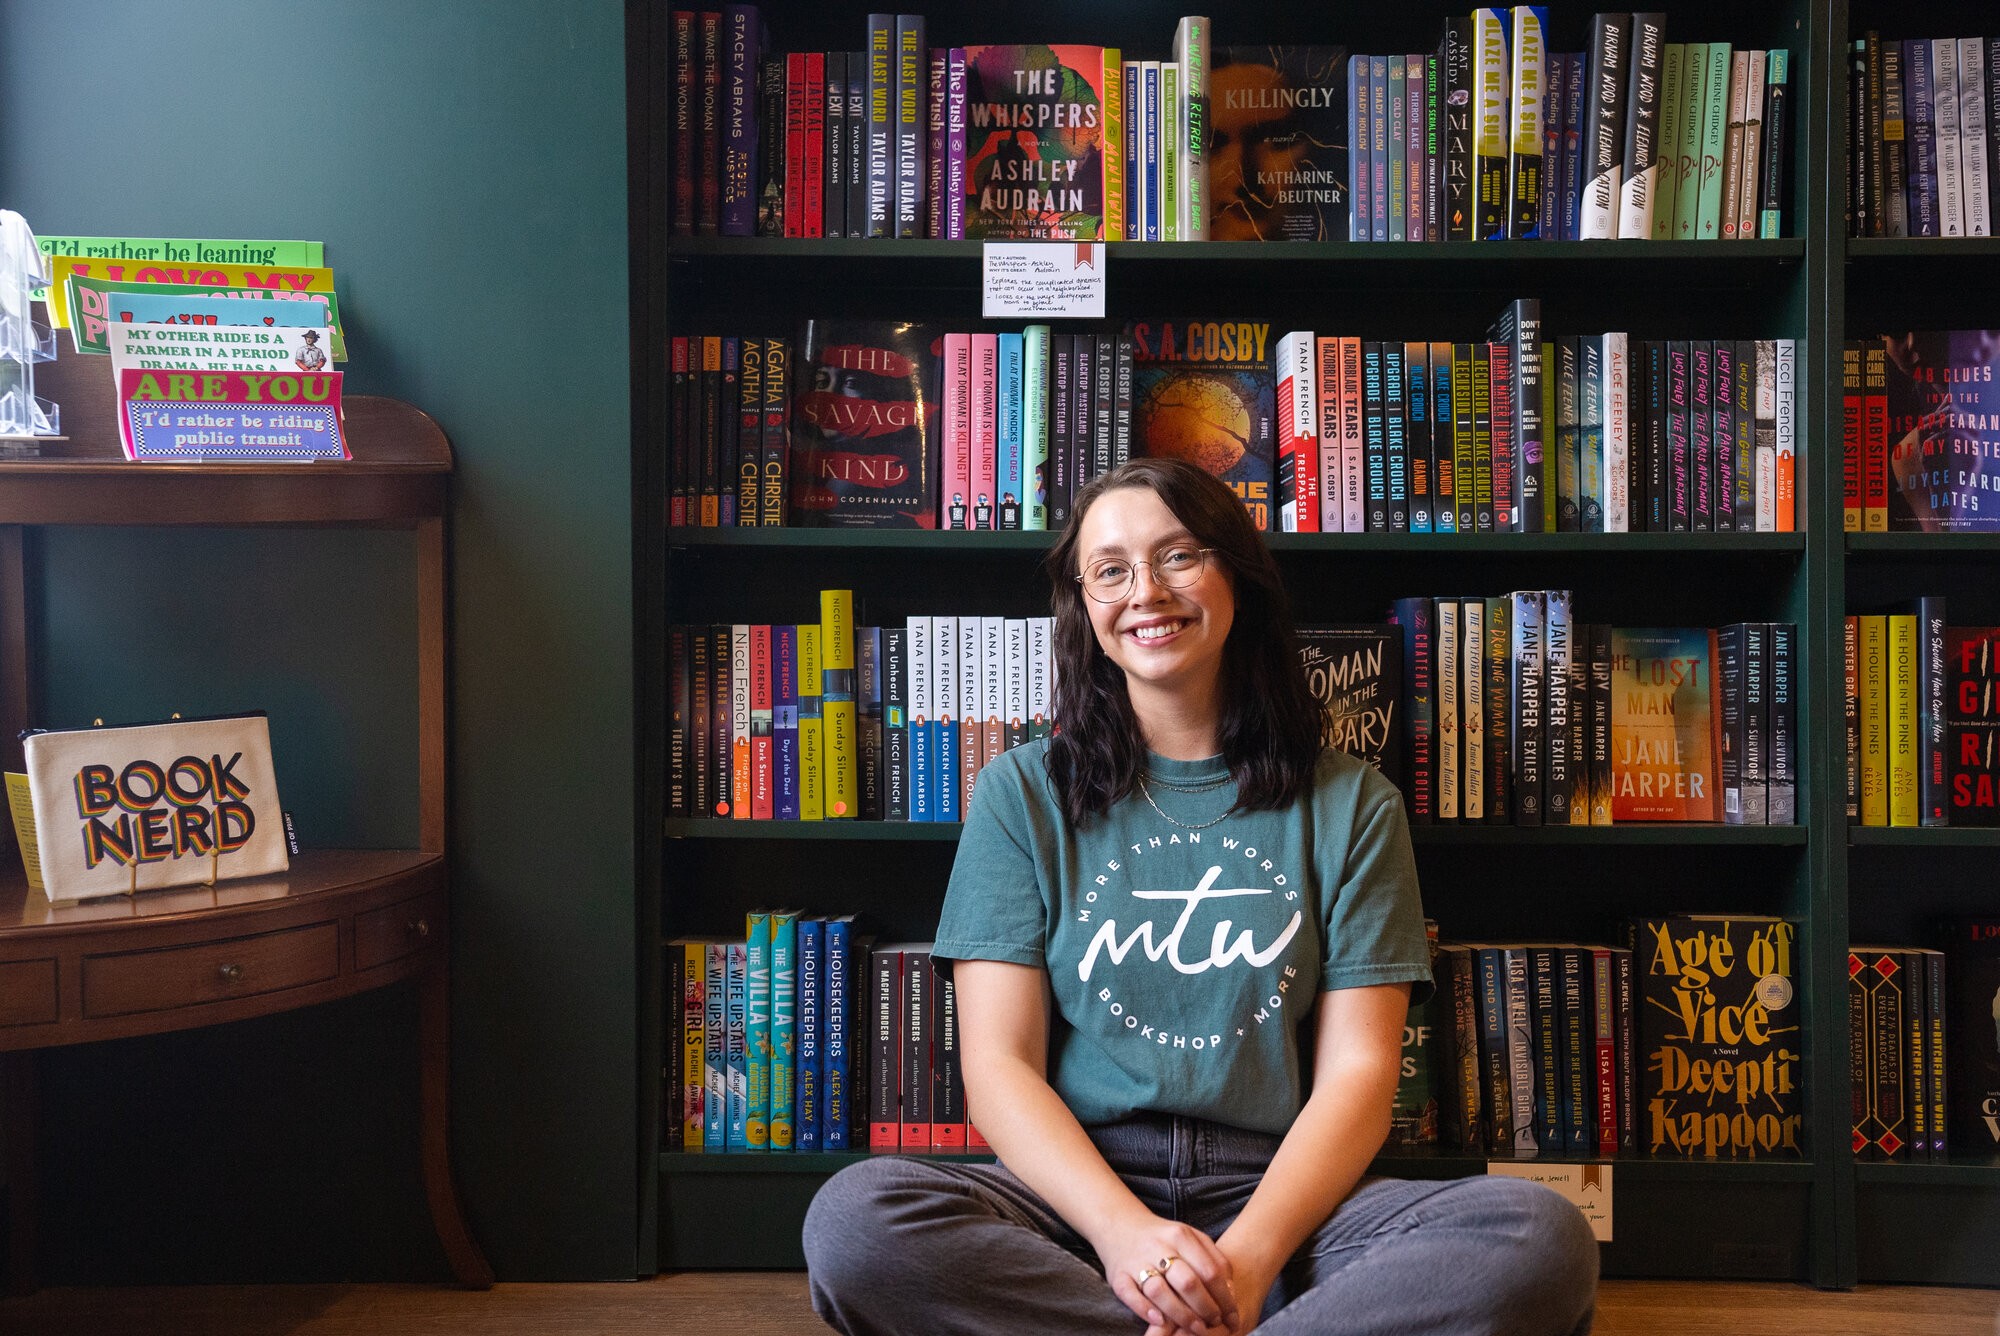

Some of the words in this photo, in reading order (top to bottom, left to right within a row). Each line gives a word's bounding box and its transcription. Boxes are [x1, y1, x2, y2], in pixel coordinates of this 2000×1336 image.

[734, 14, 744, 71] STACEY
[873, 29, 888, 51] THE
[873, 55, 887, 83] LAST
[1428, 59, 1436, 73] MY
[1448, 30, 1457, 85] CASSIDY
[1459, 45, 1468, 71] NAT
[1885, 52, 1898, 80] IRON
[950, 60, 964, 91] The
[1014, 70, 1055, 95] THE
[1428, 72, 1436, 93] SISTER
[1713, 52, 1723, 102] CATHERINE
[731, 77, 743, 138] ABRAMS
[872, 91, 887, 123] WORD
[950, 94, 964, 133] Push
[1225, 88, 1335, 109] KILLINGLY
[1358, 86, 1366, 115] SHADY
[1428, 96, 1436, 108] THE
[1886, 87, 1899, 115] LAKE
[971, 104, 1097, 128] WHISPERS
[1428, 109, 1436, 131] SERIAL
[1711, 104, 1720, 146] CHIDGEY
[1358, 117, 1366, 150] HOLLOW
[1428, 133, 1436, 155] KILLER
[871, 133, 886, 177] TAYLOR
[991, 160, 1077, 181] ASHLEY
[1448, 113, 1468, 200] MARY
[951, 158, 962, 192] Ashley
[1257, 171, 1334, 185] KATHARINE
[871, 181, 885, 221] ADAMS
[980, 189, 1083, 212] AUDRAIN
[1278, 190, 1341, 204] BEUTNER
[951, 196, 962, 238] Audrain
[86, 243, 159, 260] rather
[165, 243, 190, 263] be
[196, 244, 276, 266] leaning
[128, 330, 150, 340] MY
[156, 331, 208, 342] OTHER
[213, 332, 251, 342] RIDE
[255, 333, 269, 343] IS
[273, 334, 284, 343] A
[1521, 320, 1540, 329] DON'T
[1521, 332, 1534, 340] SAY
[125, 345, 193, 356] FARMER
[195, 347, 212, 357] IN
[216, 348, 230, 357] A
[232, 348, 289, 359] PERIOD
[1187, 323, 1270, 362] COSBY
[1298, 341, 1308, 372] TANA
[1521, 343, 1532, 351] WE
[1521, 354, 1542, 362] DIDN'T
[766, 339, 784, 403] AGATHA
[839, 349, 895, 371] THE
[1323, 343, 1336, 394] RAZORBLADE
[1521, 365, 1541, 374] WARN
[1613, 352, 1622, 388] ALICE
[1780, 346, 1792, 383] Nicci
[131, 374, 228, 401] ARE
[240, 375, 333, 401] YOU
[1365, 353, 1379, 402] UPGRADE
[1456, 360, 1470, 414] RECURSION
[1522, 377, 1536, 385] YOU
[1301, 376, 1309, 425] FRENCH
[142, 411, 170, 427] I'd
[177, 412, 235, 428] rather
[241, 414, 263, 428] be
[269, 415, 324, 431] riding
[1324, 398, 1337, 439] TEARS
[1367, 417, 1382, 450] BLAKE
[1614, 393, 1622, 442] FEENEY
[1780, 391, 1792, 444] French
[174, 431, 235, 448] public
[241, 433, 302, 446] transit
[1869, 406, 1883, 498] BABYSITTER
[822, 458, 904, 480] KIND
[1369, 455, 1384, 500] CROUCH
[1413, 459, 1426, 495] ABANDON
[764, 462, 781, 525] CHRISTIE
[840, 496, 918, 505] COPENHAVER
[1297, 453, 1306, 521] TRESPASSER
[1308, 477, 1316, 497] THE
[1470, 612, 1479, 626] THE
[1899, 625, 1907, 643] THE
[735, 634, 747, 671] Nicci
[756, 630, 764, 660] NICCI
[889, 634, 899, 653] The
[916, 625, 924, 657] TANA
[1470, 630, 1479, 676] TWYFORD
[1523, 621, 1538, 660] JANE
[1749, 630, 1761, 656] JANE
[1845, 624, 1854, 670] SINISTER
[781, 663, 789, 699] FRENCH
[890, 656, 899, 700] Unheard
[1636, 659, 1701, 687] LOST
[1748, 661, 1760, 703] HARPER
[1898, 648, 1908, 685] HOUSE
[757, 664, 765, 705] FRENCH
[916, 664, 924, 709] FRENCH
[1470, 679, 1479, 705] CODE
[1522, 667, 1538, 728] HARPER
[1846, 676, 1855, 717] GRAVES
[1900, 688, 1908, 699] IN
[735, 678, 748, 730] French
[1627, 692, 1675, 716] MAN
[1900, 702, 1908, 720] THE
[834, 712, 845, 751] Sunday
[1900, 725, 1909, 755] PINES
[1524, 741, 1536, 783] EXILES
[1621, 738, 1684, 765] JANE
[73, 752, 251, 820] BOOK
[757, 764, 766, 800] Saturday
[837, 754, 846, 795] Silence
[81, 801, 256, 870] NERD
[289, 832, 295, 840] OF
[1078, 860, 1120, 922] MORE
[1132, 833, 1201, 855] THAN
[1223, 837, 1298, 901] WORDS
[1078, 866, 1301, 982] mtw
[750, 946, 760, 966] THE
[1598, 961, 1606, 978] THE
[1648, 921, 1735, 988] Age
[1747, 921, 1794, 978] of
[730, 968, 742, 998] WIFE
[749, 969, 769, 1025] VILLA
[880, 970, 889, 1001] MAGPIE
[1485, 965, 1496, 1003] FOUND
[1599, 981, 1607, 1009] THIRD
[803, 950, 815, 1057] HOUSEKEEPERS
[1099, 988, 1221, 1050] BOOKSHOP
[1253, 965, 1297, 1024] MORE
[1488, 1007, 1497, 1032] YOU
[1664, 984, 1780, 1046] Vice
[730, 1002, 743, 1062] UPSTAIRS
[880, 1004, 889, 1041] MURDERS
[1599, 1012, 1608, 1035] WIFE
[1514, 1041, 1529, 1092] INVISIBLE
[1932, 1031, 1943, 1076] BUTCHER
[1648, 1046, 1800, 1113] Deepti
[1517, 1095, 1530, 1118] GIRL
[1934, 1104, 1943, 1133] WREN
[1648, 1098, 1803, 1158] Kapoor
